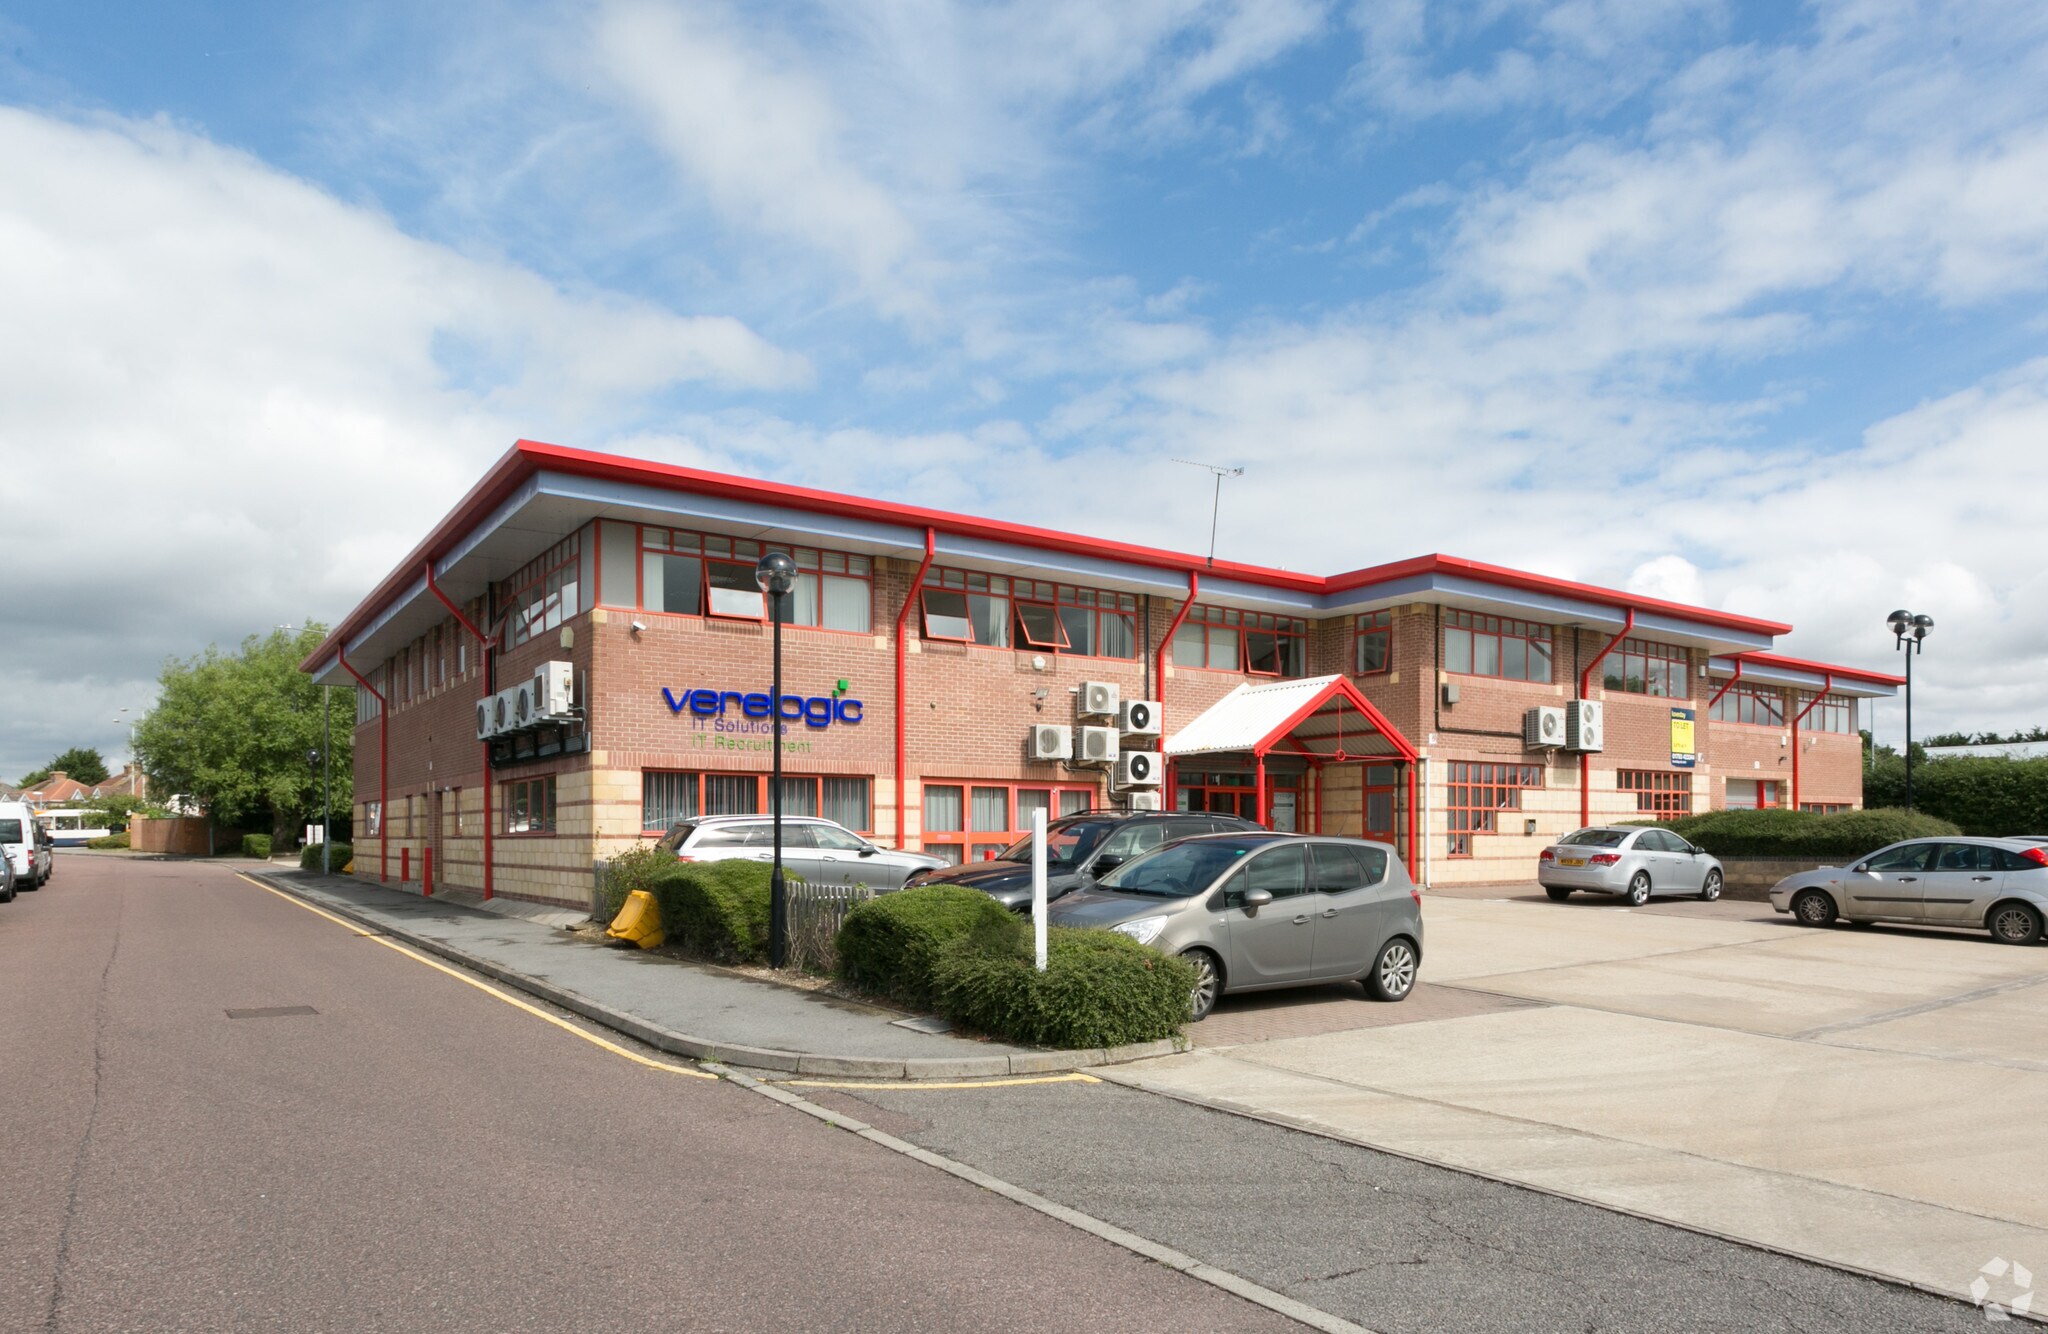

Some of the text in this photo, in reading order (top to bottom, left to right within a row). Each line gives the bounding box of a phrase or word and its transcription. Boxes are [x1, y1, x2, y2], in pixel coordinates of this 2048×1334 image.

[661, 684, 864, 727] verelogic
[692, 716, 707, 731] IT
[692, 734, 707, 749] IT
